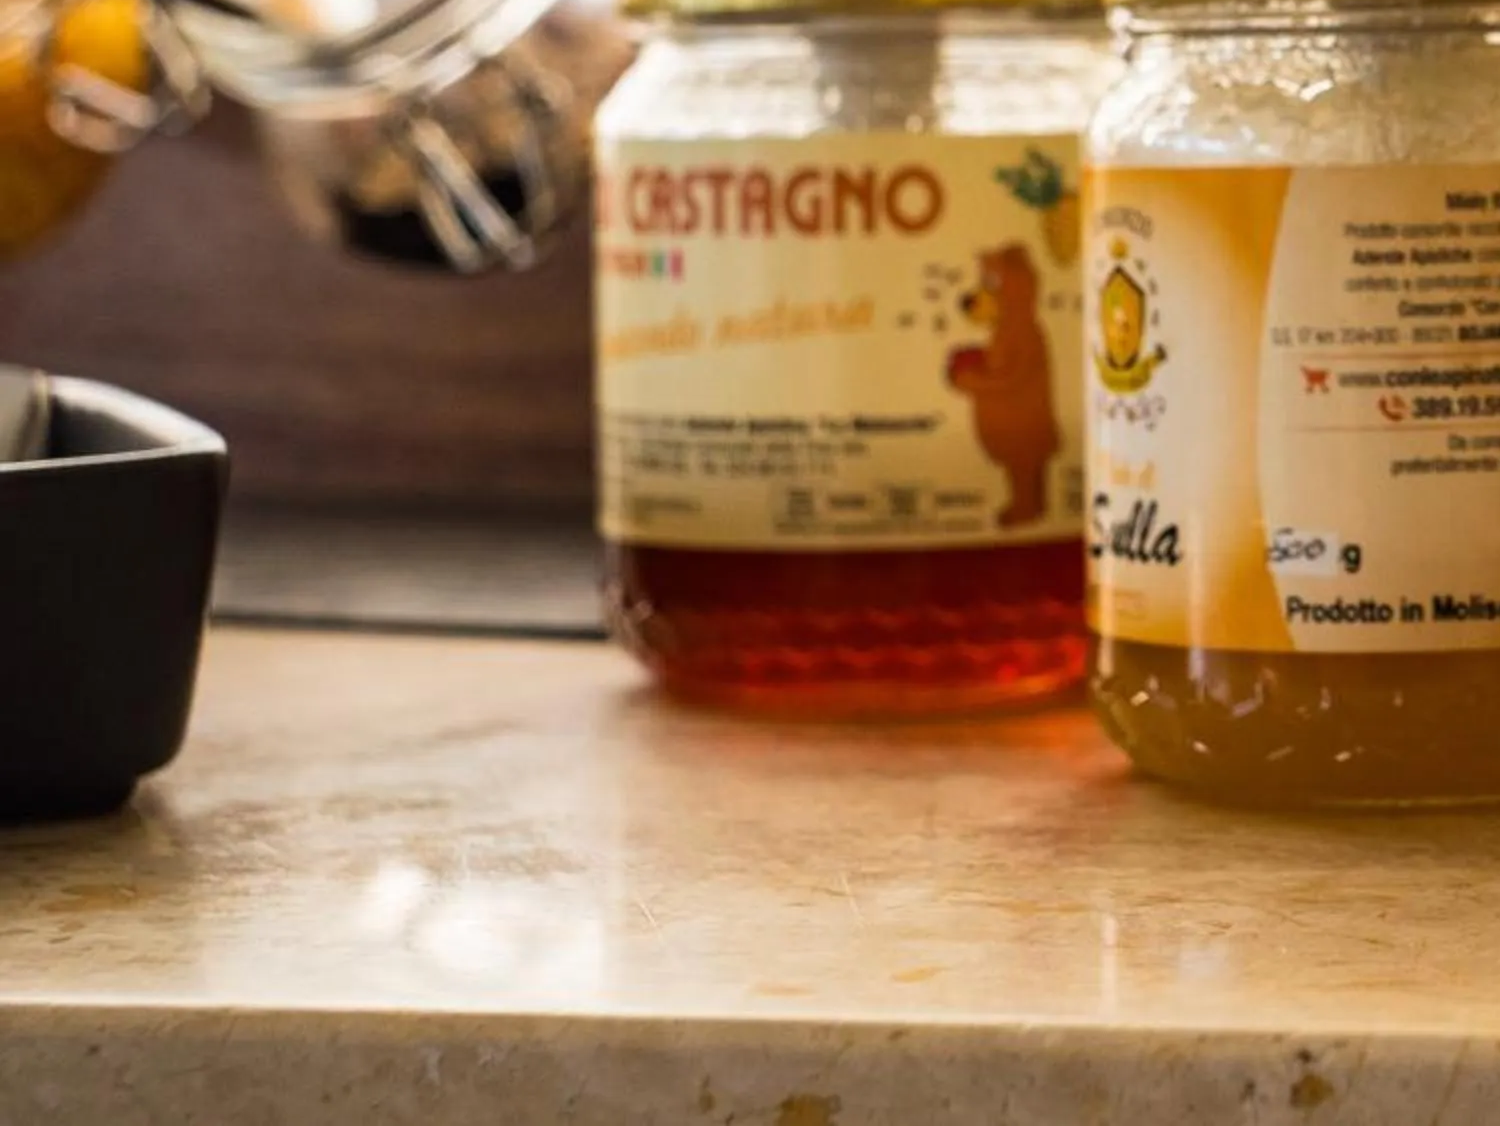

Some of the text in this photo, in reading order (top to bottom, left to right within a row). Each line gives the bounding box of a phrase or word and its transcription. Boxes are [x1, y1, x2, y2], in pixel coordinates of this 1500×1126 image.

[628, 164, 945, 237] CASTAGNO
[1286, 595, 1394, 625] Prodotto
[1401, 594, 1424, 623] in
